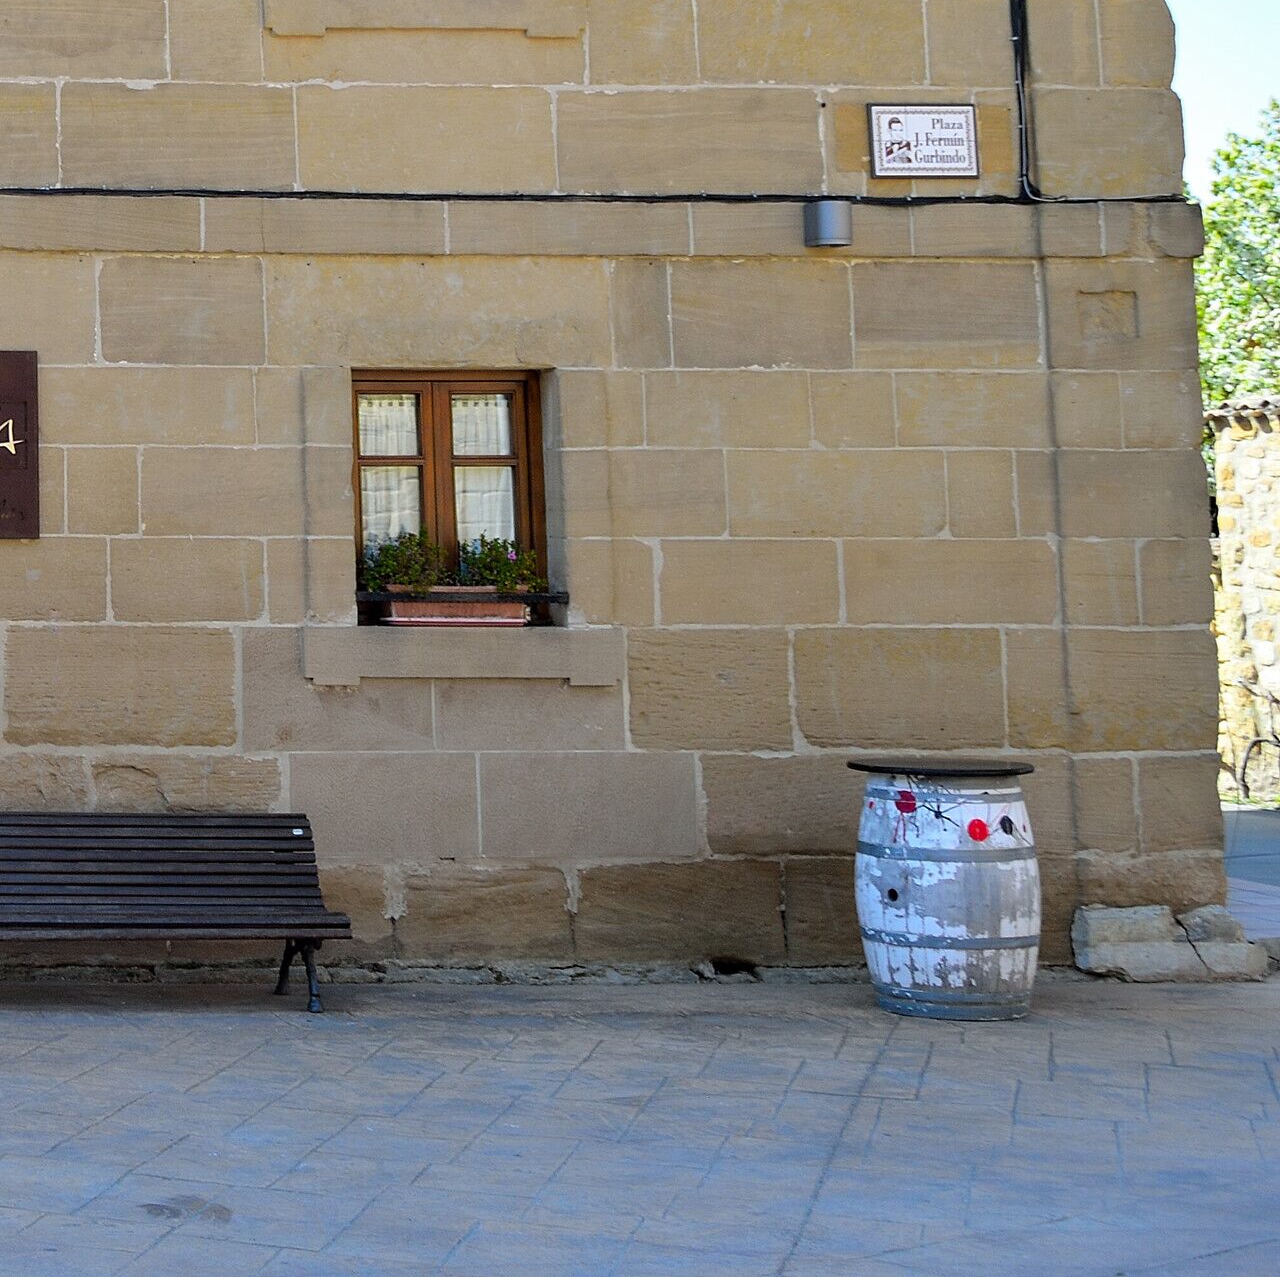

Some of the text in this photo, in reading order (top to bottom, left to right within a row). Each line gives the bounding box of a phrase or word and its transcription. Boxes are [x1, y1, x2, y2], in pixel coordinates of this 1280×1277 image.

[931, 118, 963, 129] Plaza
[913, 132, 965, 148] J. Fermín
[914, 149, 966, 164] Gurbindo
